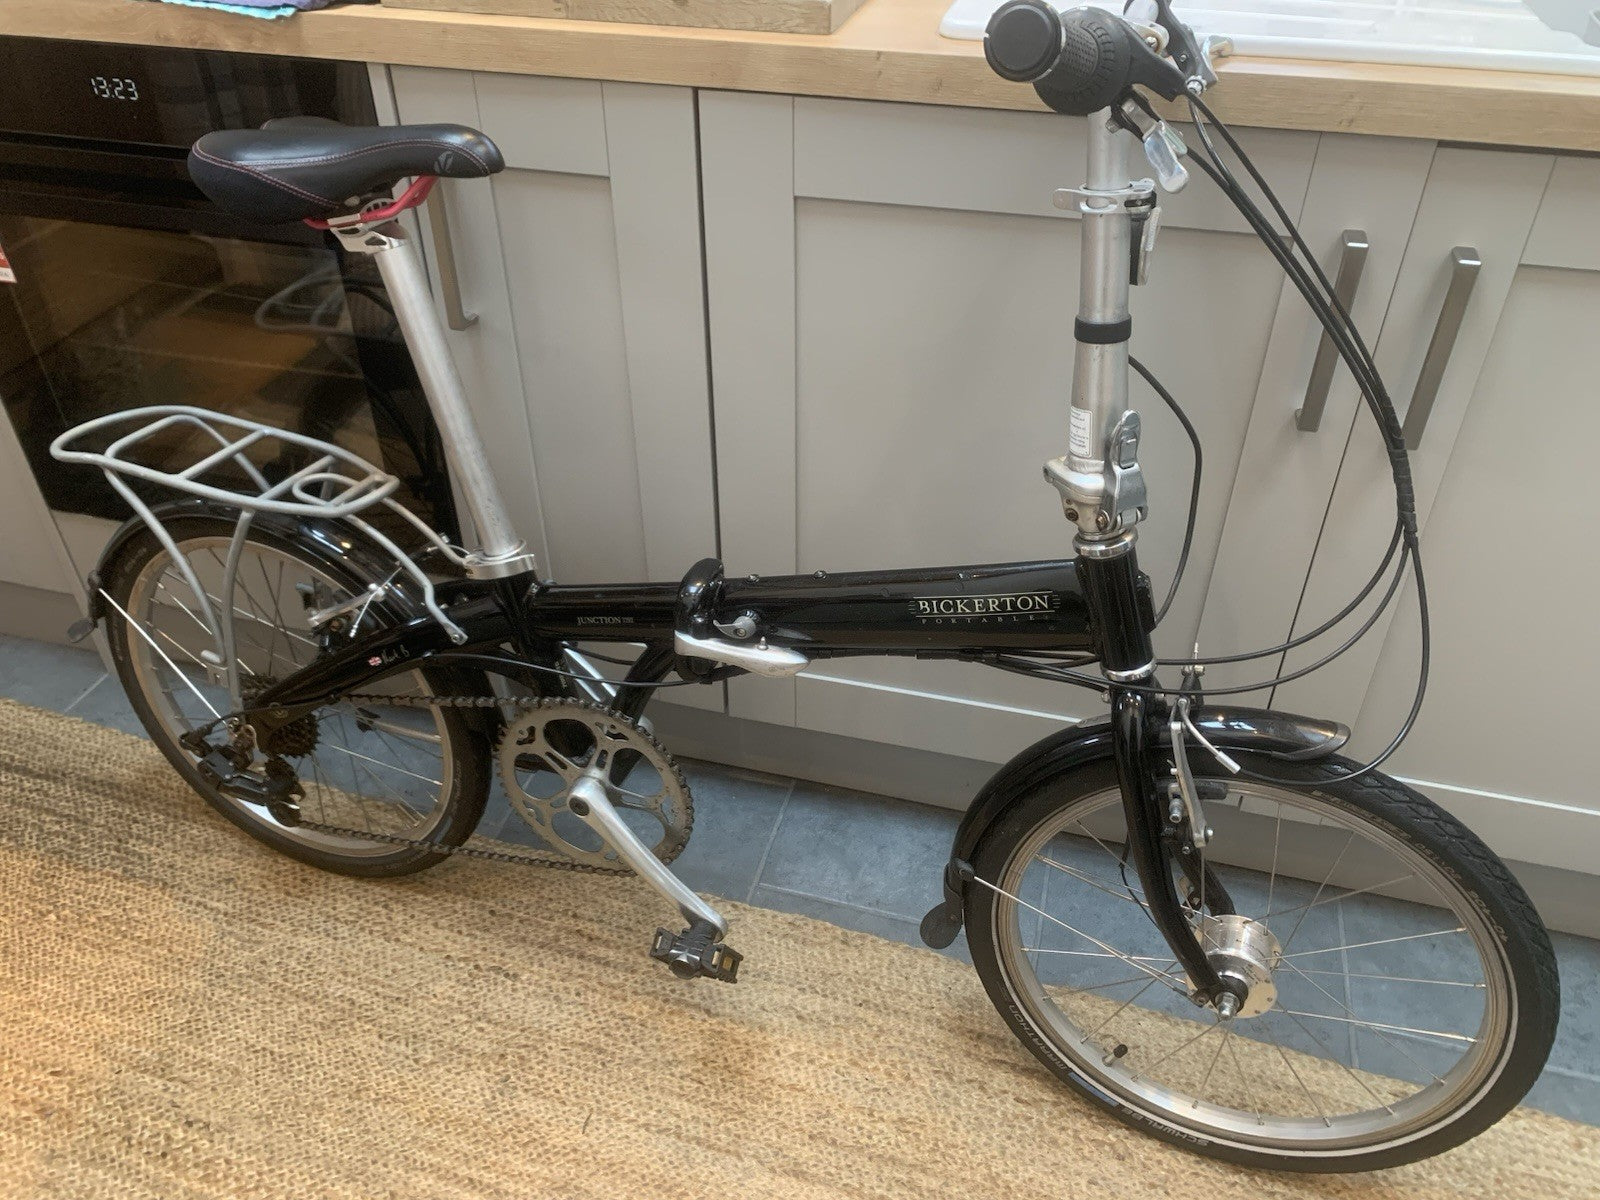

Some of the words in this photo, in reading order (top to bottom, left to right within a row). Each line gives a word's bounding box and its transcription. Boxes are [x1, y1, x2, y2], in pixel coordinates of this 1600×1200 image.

[91, 77, 138, 100] 13:23
[918, 595, 1050, 614] BICKERTON
[577, 616, 621, 626] JUNCTION
[1121, 1106, 1209, 1147] SCHWALBE
